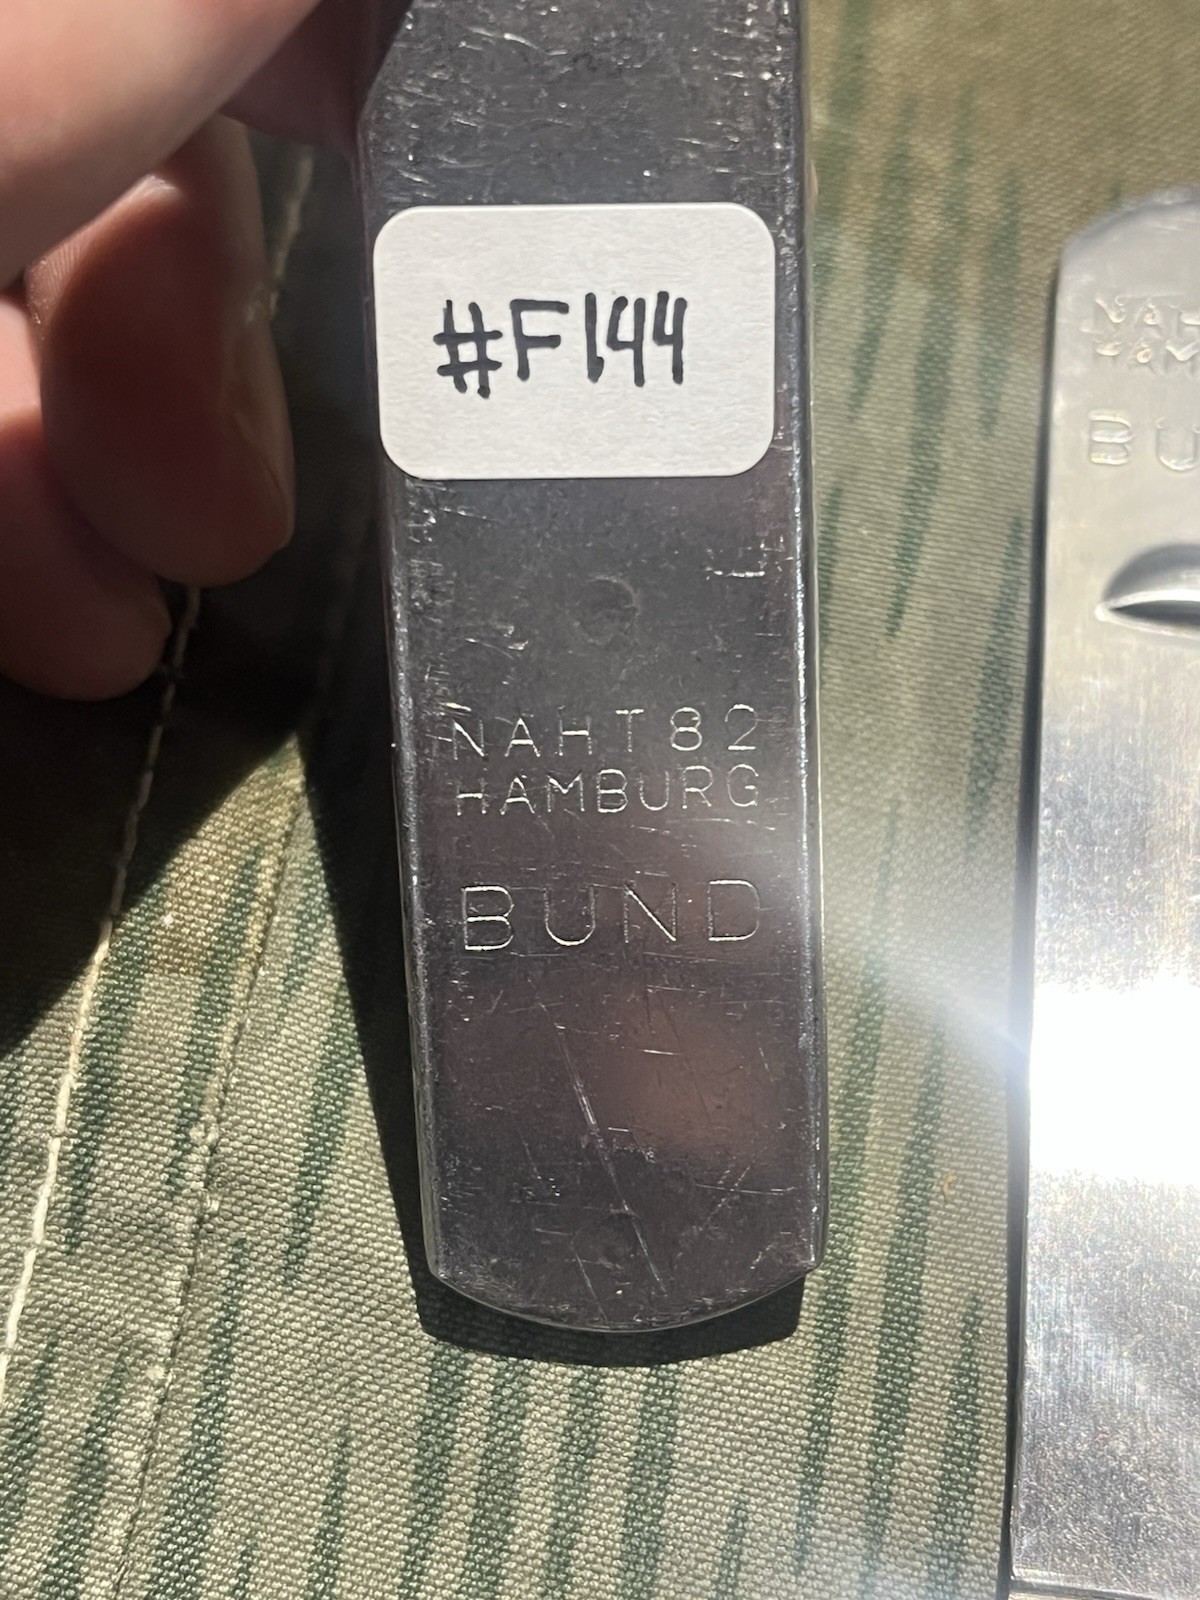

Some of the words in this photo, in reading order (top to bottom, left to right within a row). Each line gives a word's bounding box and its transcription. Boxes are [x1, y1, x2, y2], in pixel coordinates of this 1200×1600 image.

[433, 290, 688, 399] #F144
[455, 763, 760, 815] HAMBURG
[461, 878, 760, 951] BUND
